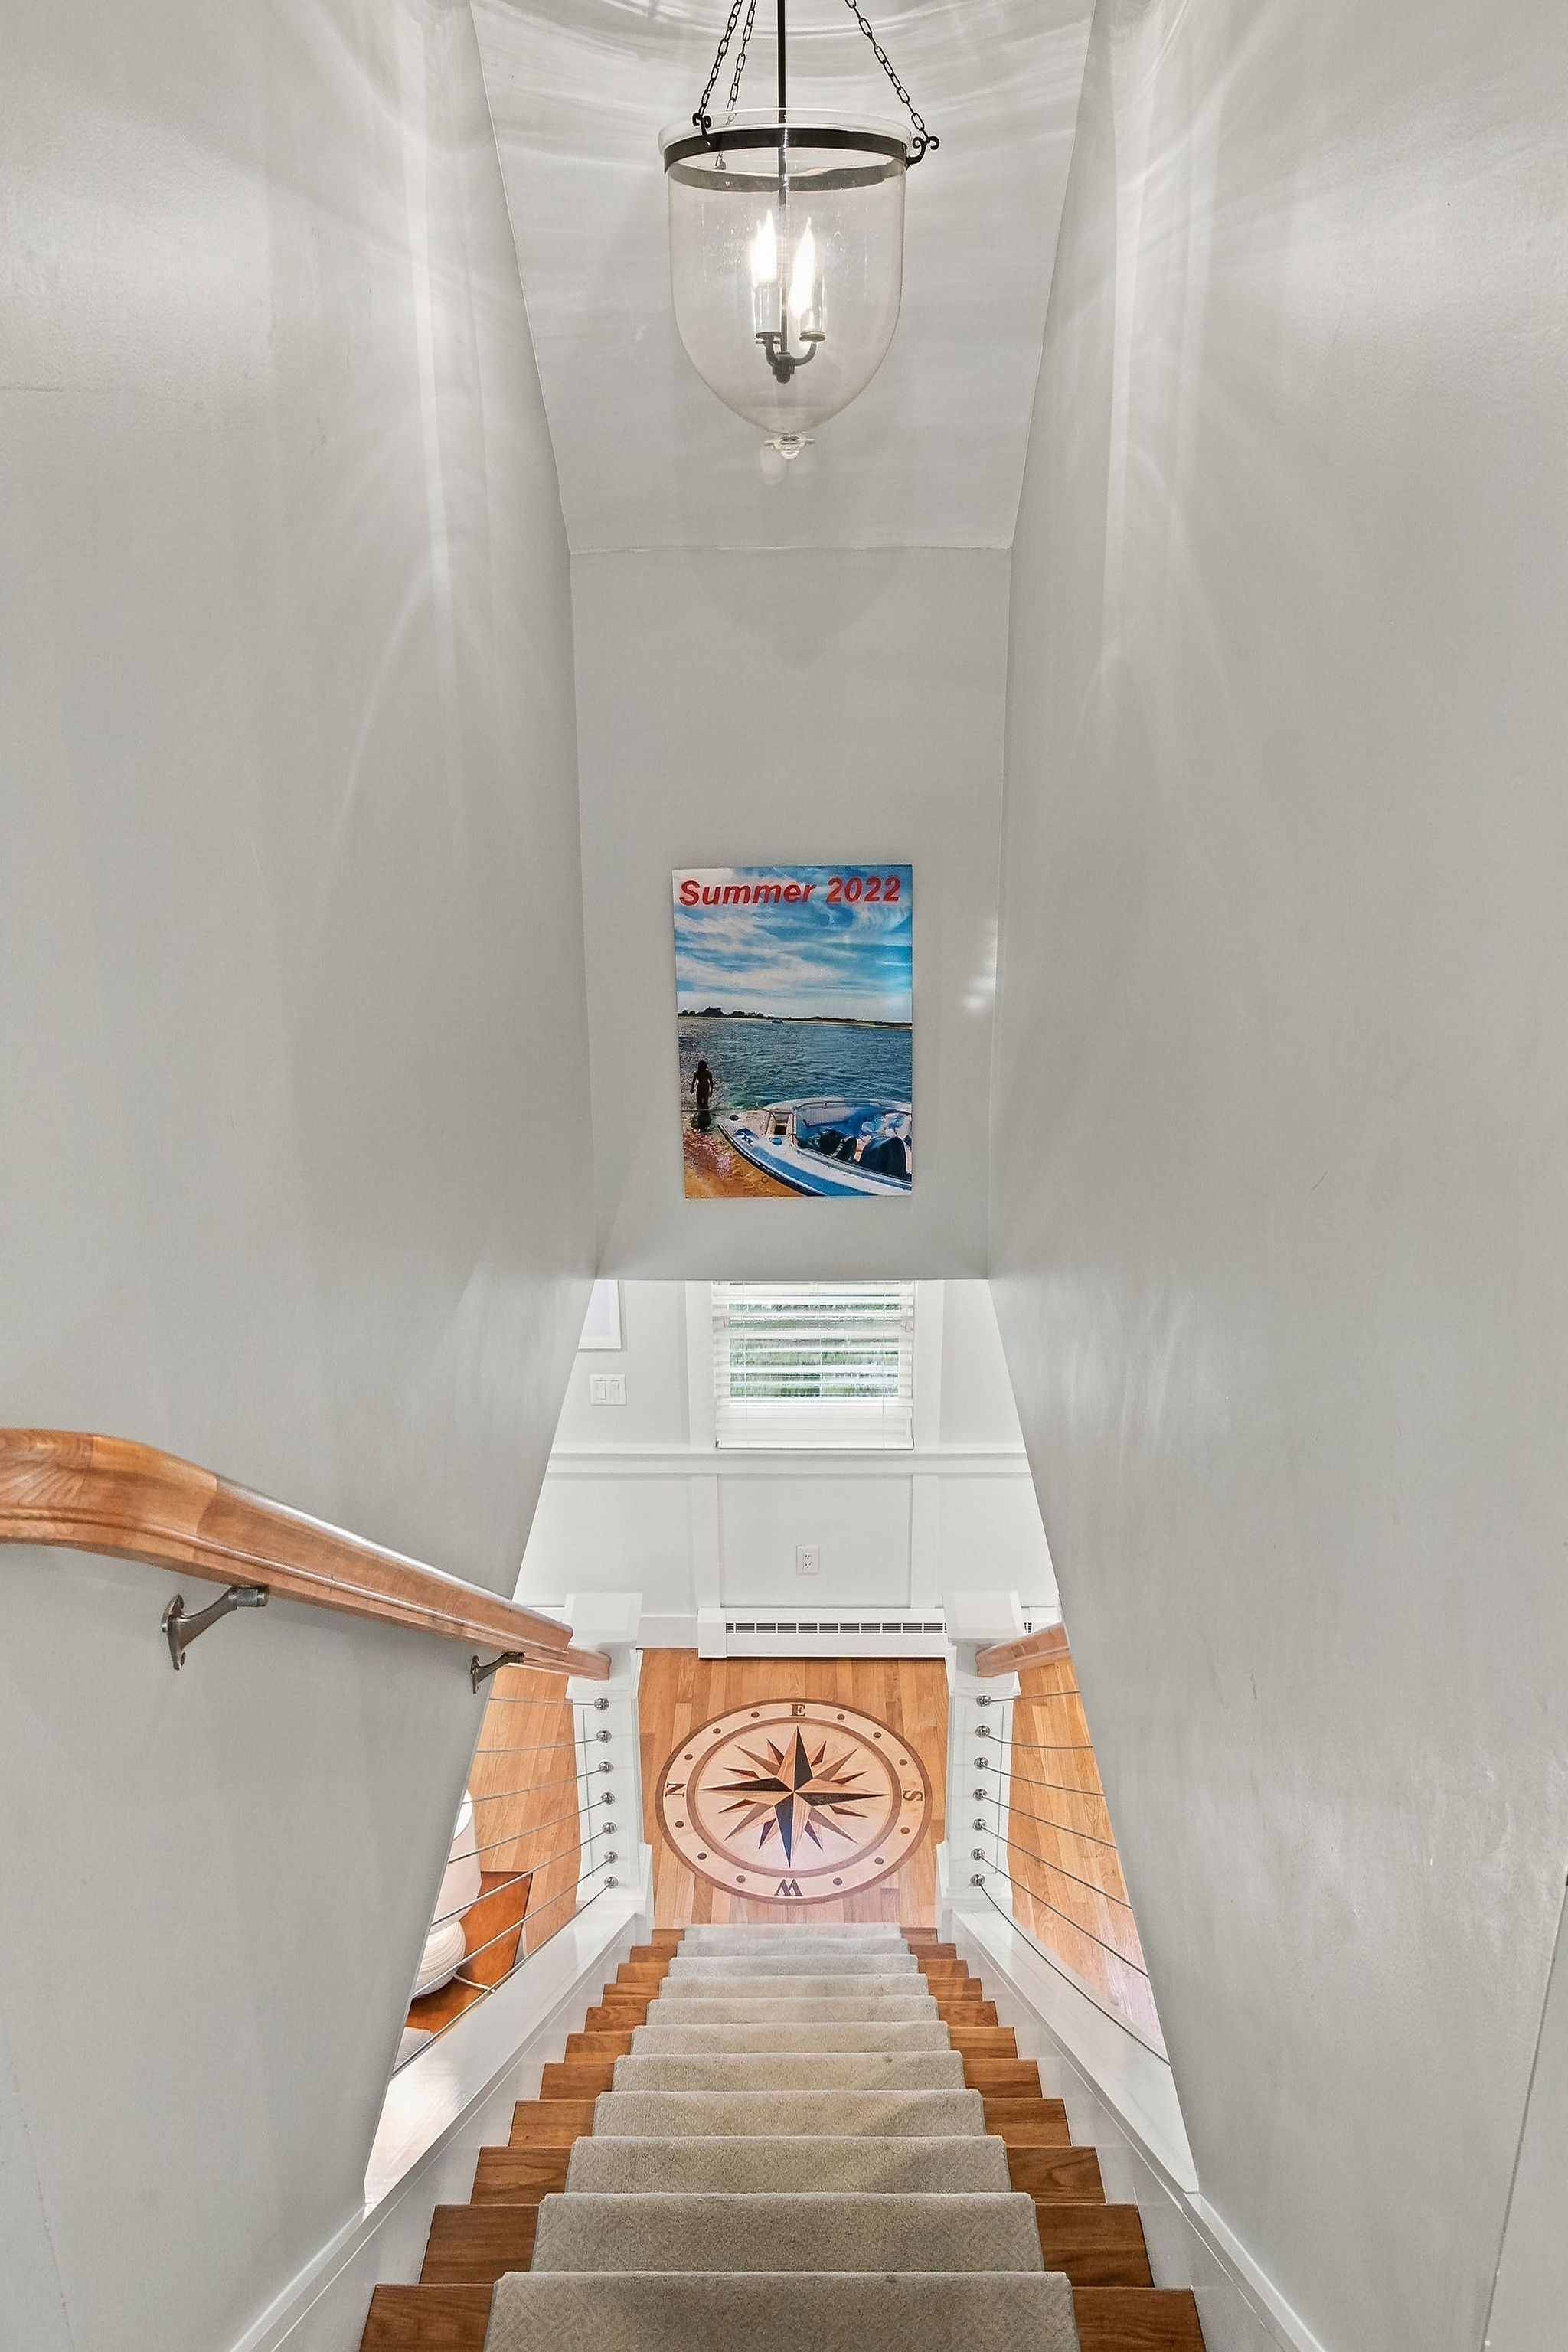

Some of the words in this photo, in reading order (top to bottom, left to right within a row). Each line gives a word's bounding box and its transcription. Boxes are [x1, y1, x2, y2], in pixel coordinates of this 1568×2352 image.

[679, 880, 816, 906] Summer
[826, 877, 900, 903] 2022
[790, 1704, 806, 1717] E
[665, 1782, 686, 1798] N
[903, 1789, 923, 1802] S
[774, 1878, 804, 1896] W
